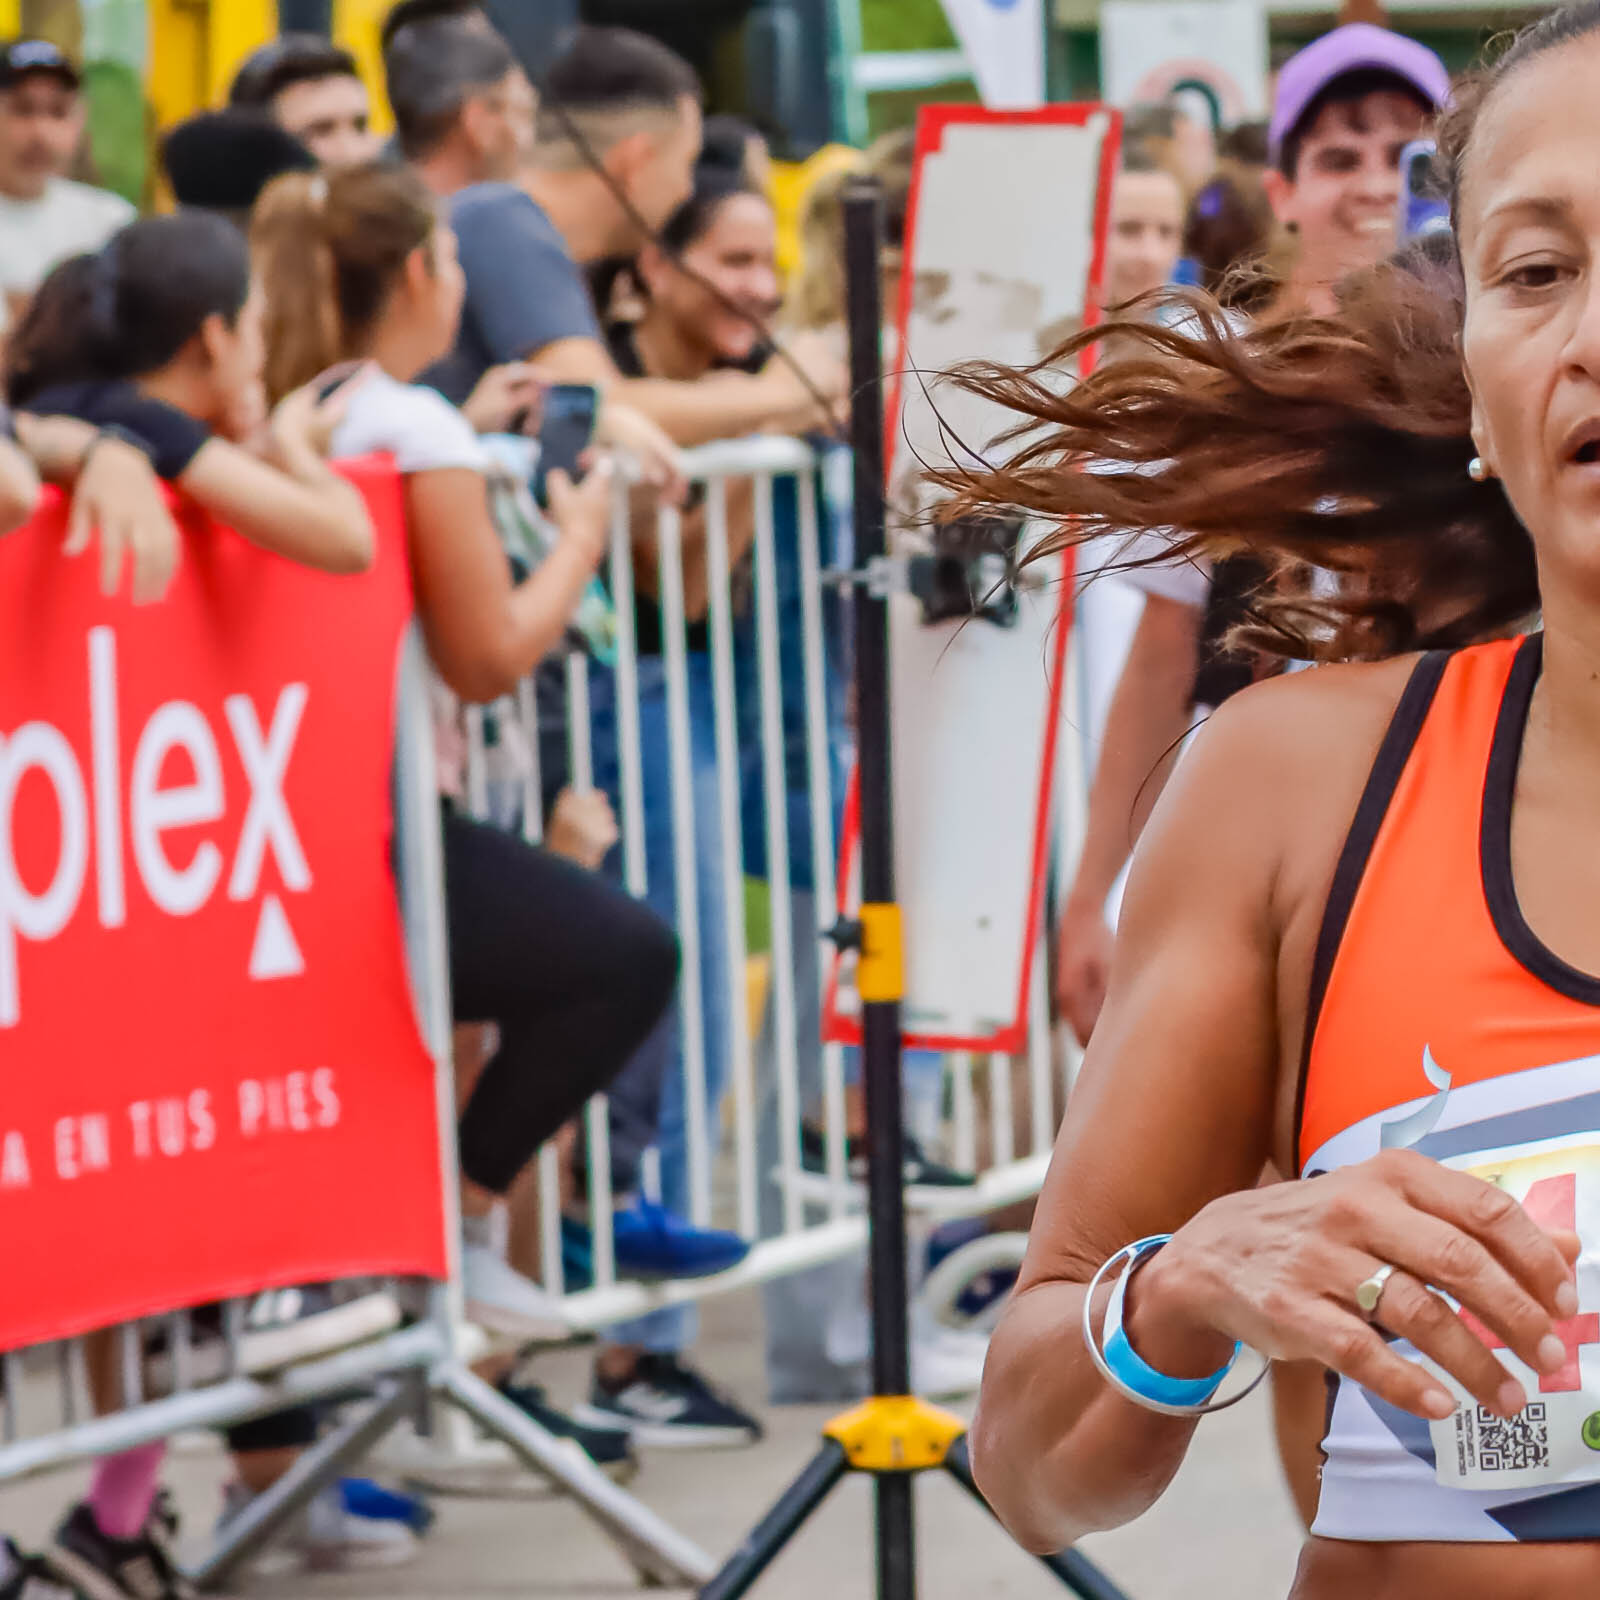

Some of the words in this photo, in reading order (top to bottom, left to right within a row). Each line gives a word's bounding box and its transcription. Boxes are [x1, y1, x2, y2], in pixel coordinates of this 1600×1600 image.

[54, 1112, 111, 1180] EN
[127, 1087, 217, 1158] TUS
[238, 1065, 341, 1140] PIES
